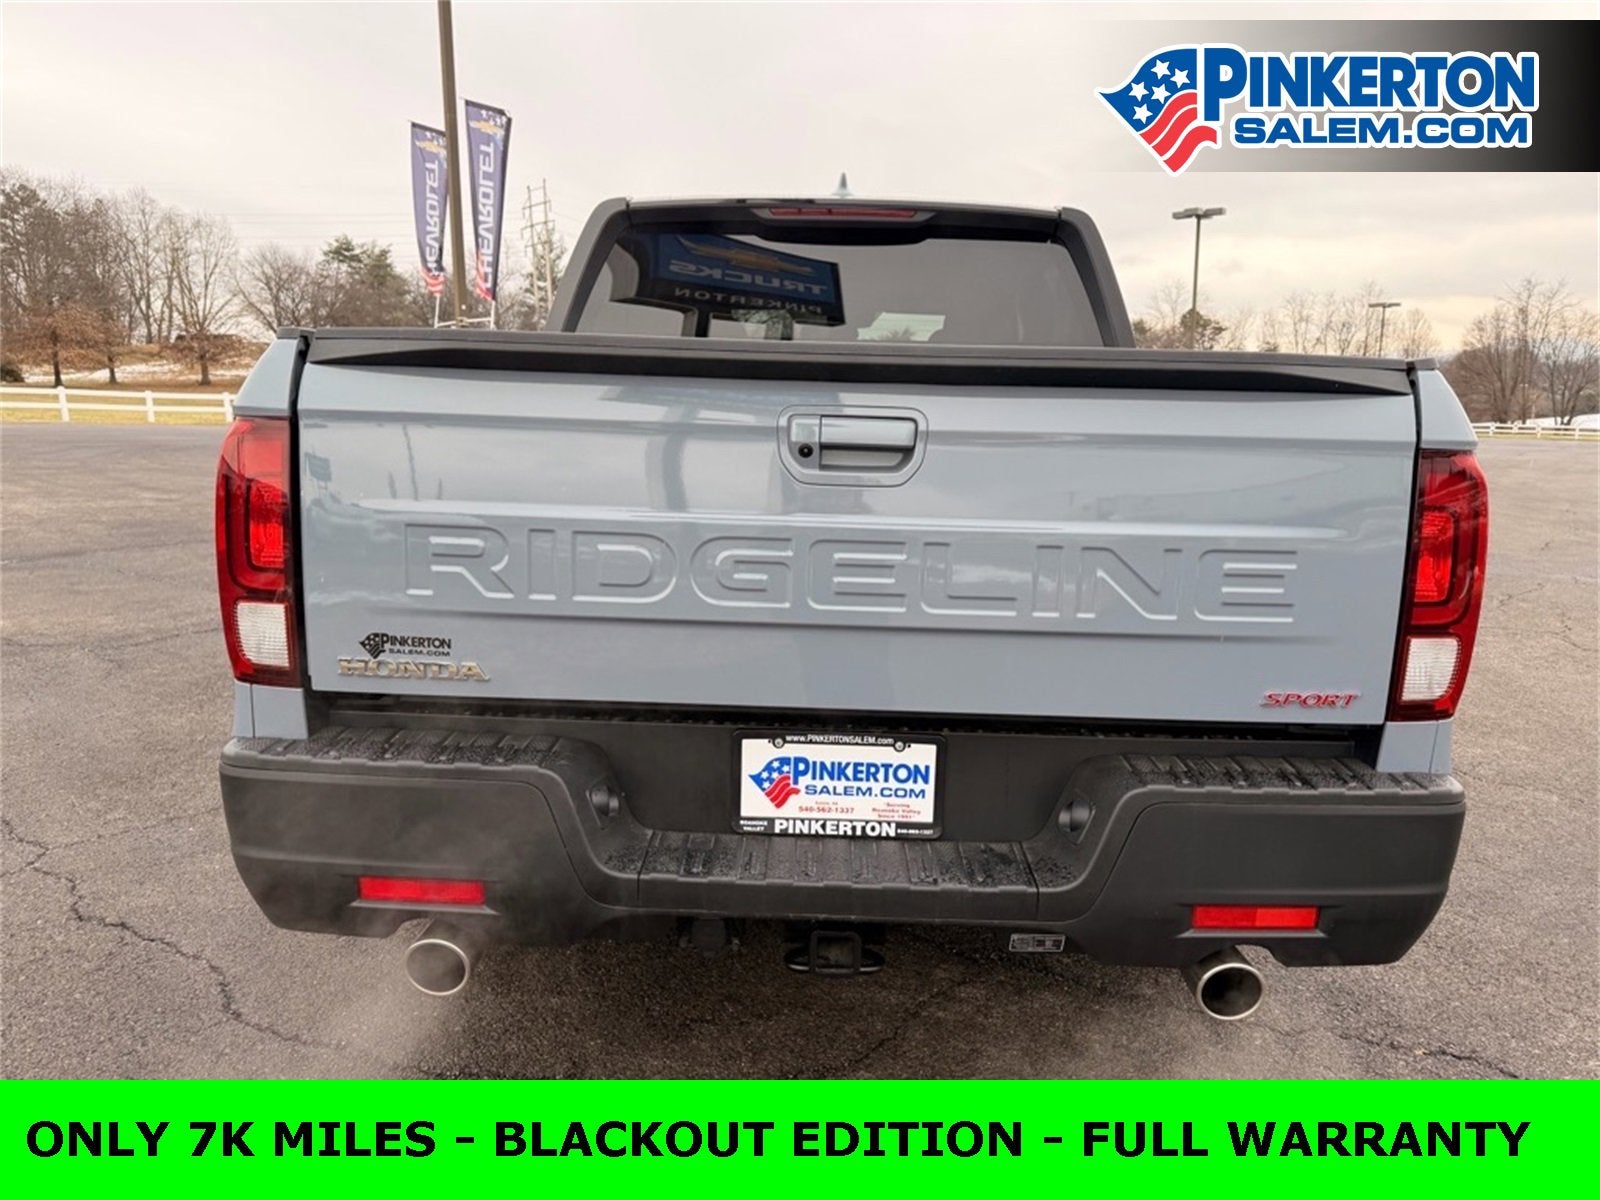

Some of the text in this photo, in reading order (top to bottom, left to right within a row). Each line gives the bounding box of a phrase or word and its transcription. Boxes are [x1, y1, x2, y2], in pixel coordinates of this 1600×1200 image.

[405, 523, 1299, 623] RIDGELINE
[380, 633, 452, 650] PINKERTON
[388, 648, 451, 657] SALEM.COM
[337, 657, 491, 682] HONDA
[1262, 690, 1361, 708] SPORT
[786, 734, 894, 745] www.PINKERTONSALEM.com
[792, 757, 930, 785] PINKERTON
[804, 785, 926, 799] SALEM.COM
[774, 819, 896, 837] PINKERTON
